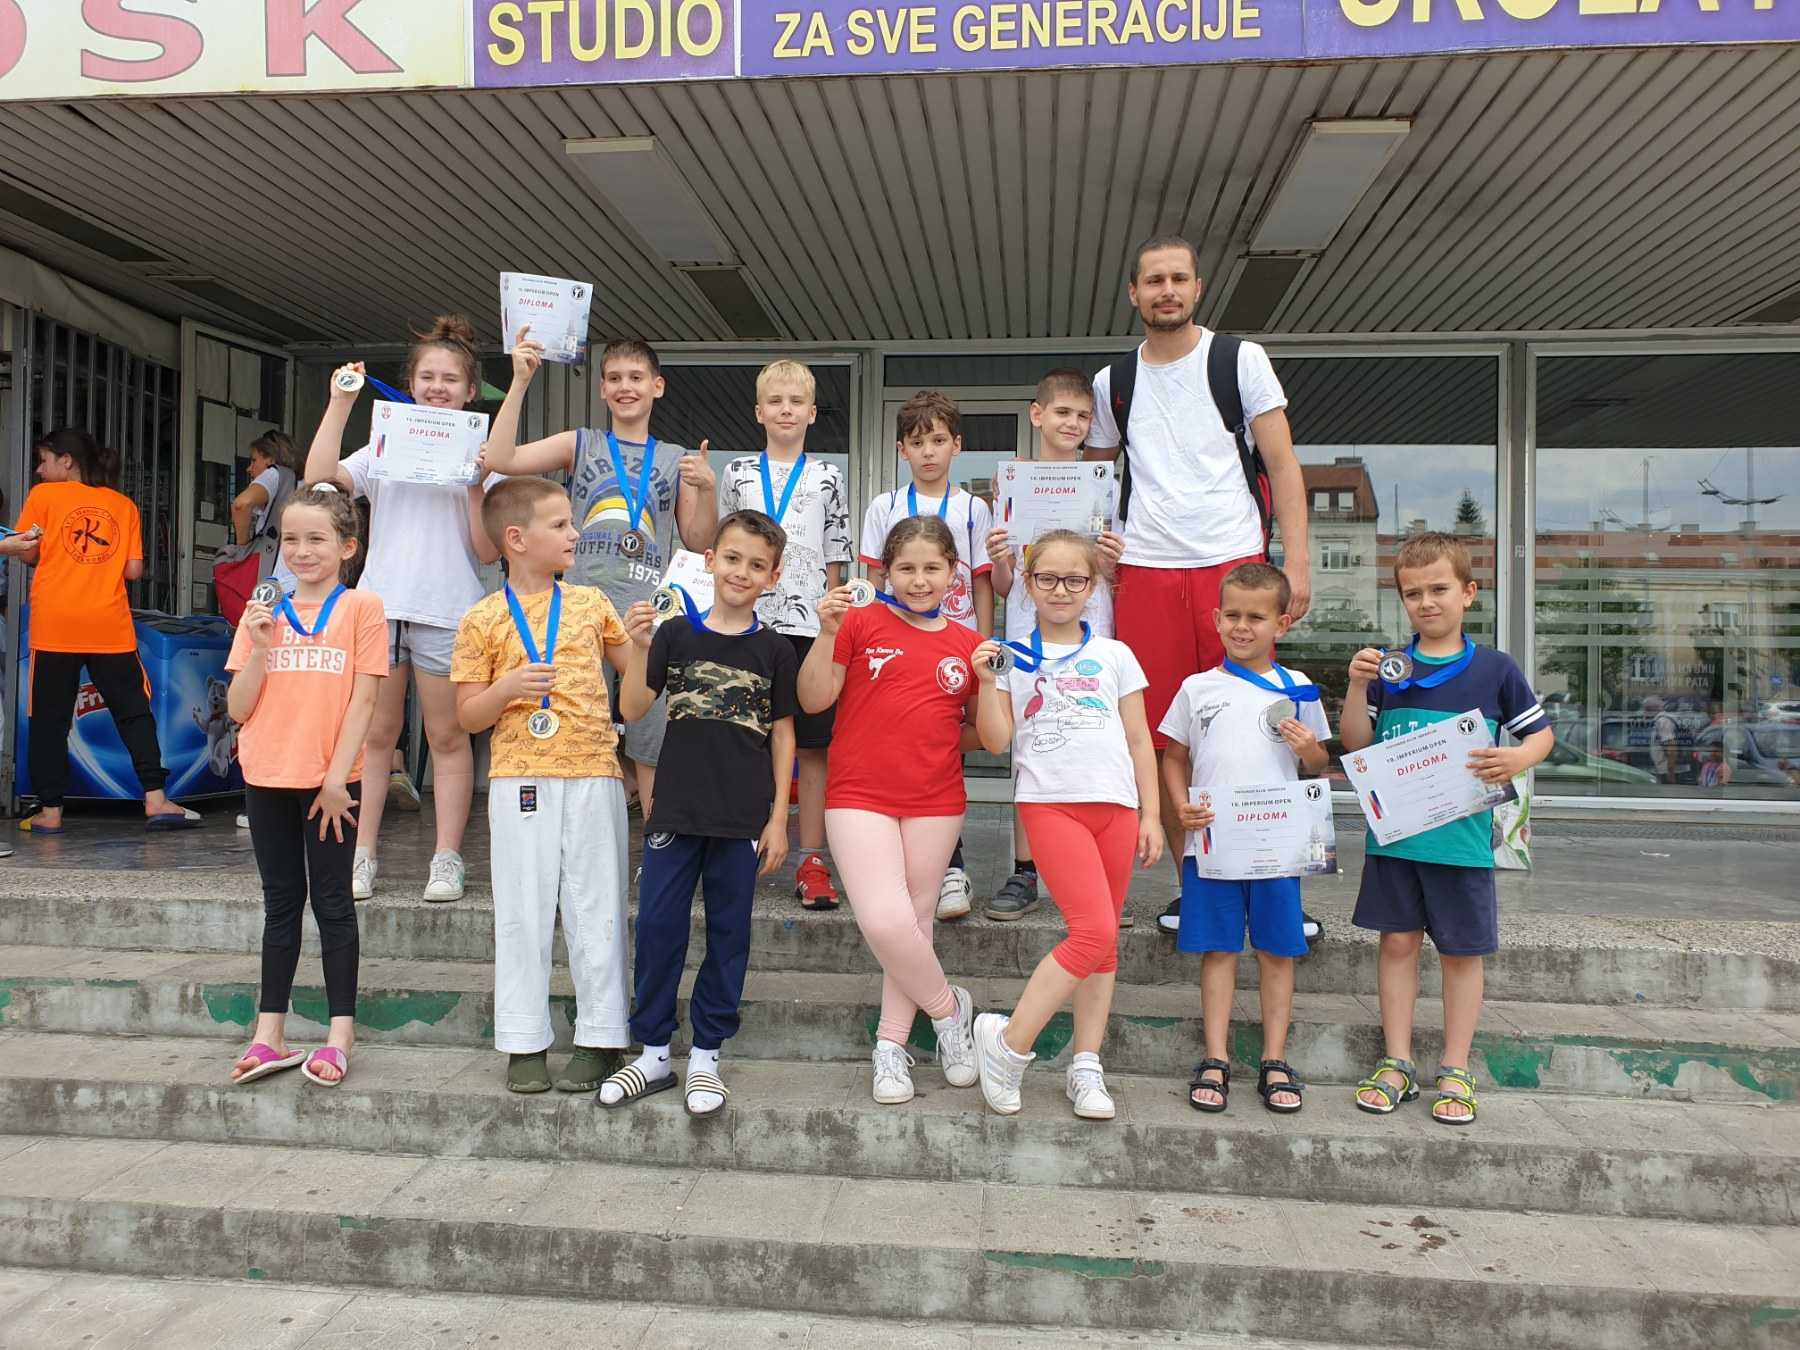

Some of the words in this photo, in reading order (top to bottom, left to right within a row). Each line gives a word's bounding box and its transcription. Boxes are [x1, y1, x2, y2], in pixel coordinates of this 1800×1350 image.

[0, 0, 404, 82] SK
[487, 0, 723, 66] STUDIO
[773, 11, 834, 58] ZA
[847, 7, 937, 56] SVE
[952, 0, 1261, 51] GENERACIJE
[518, 297, 554, 309] DIPLOMA
[409, 427, 450, 440] DIPLOMA
[576, 455, 671, 512] SURZONE
[1034, 487, 1077, 495] DIPLOMA
[628, 562, 661, 586] 1975
[267, 649, 343, 672] SISTERS
[1396, 752, 1449, 777] DIPLOMA
[1237, 811, 1288, 822] DIPLOMA
